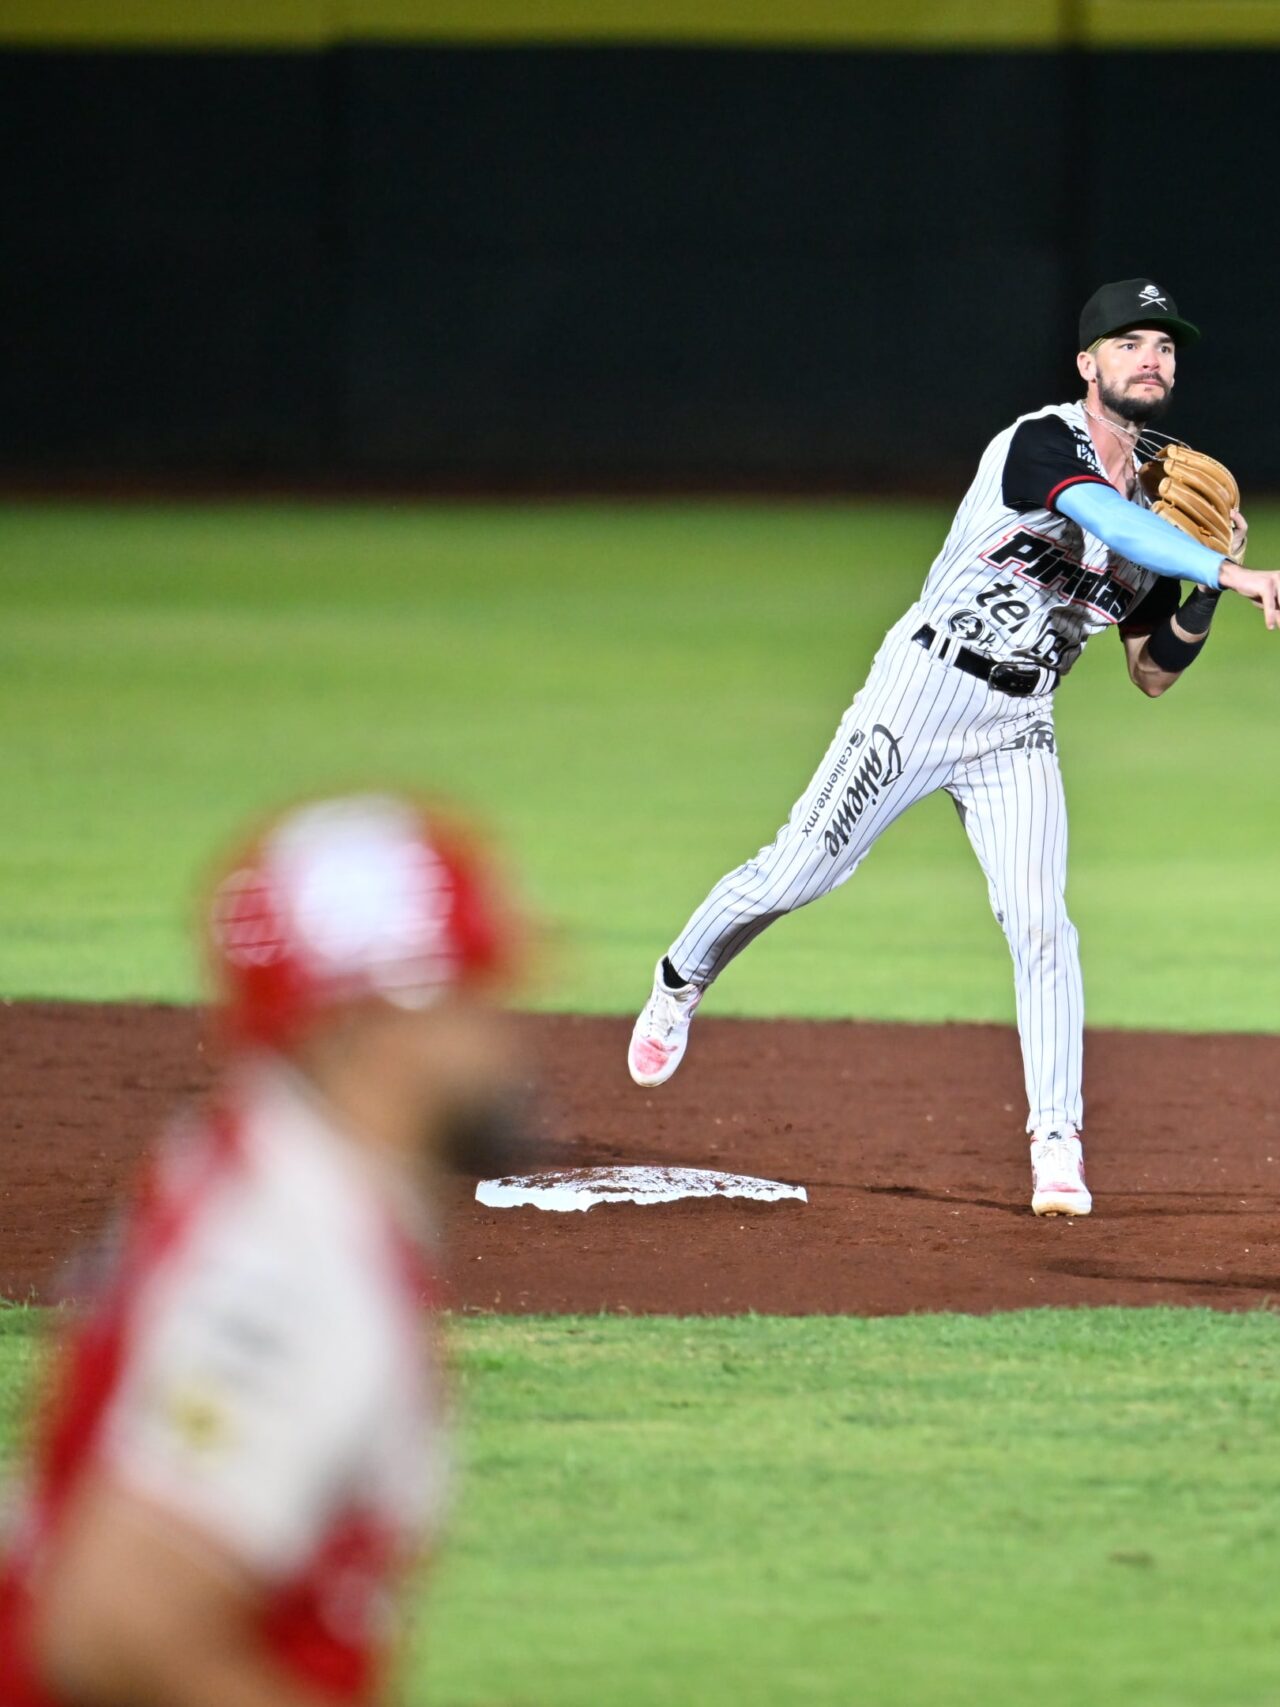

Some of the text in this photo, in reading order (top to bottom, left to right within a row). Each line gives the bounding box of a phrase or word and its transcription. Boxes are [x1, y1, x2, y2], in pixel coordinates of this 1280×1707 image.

[980, 526, 1136, 624] Piratas
[802, 745, 853, 838] caliente.mx
[824, 723, 904, 857] Caliente
